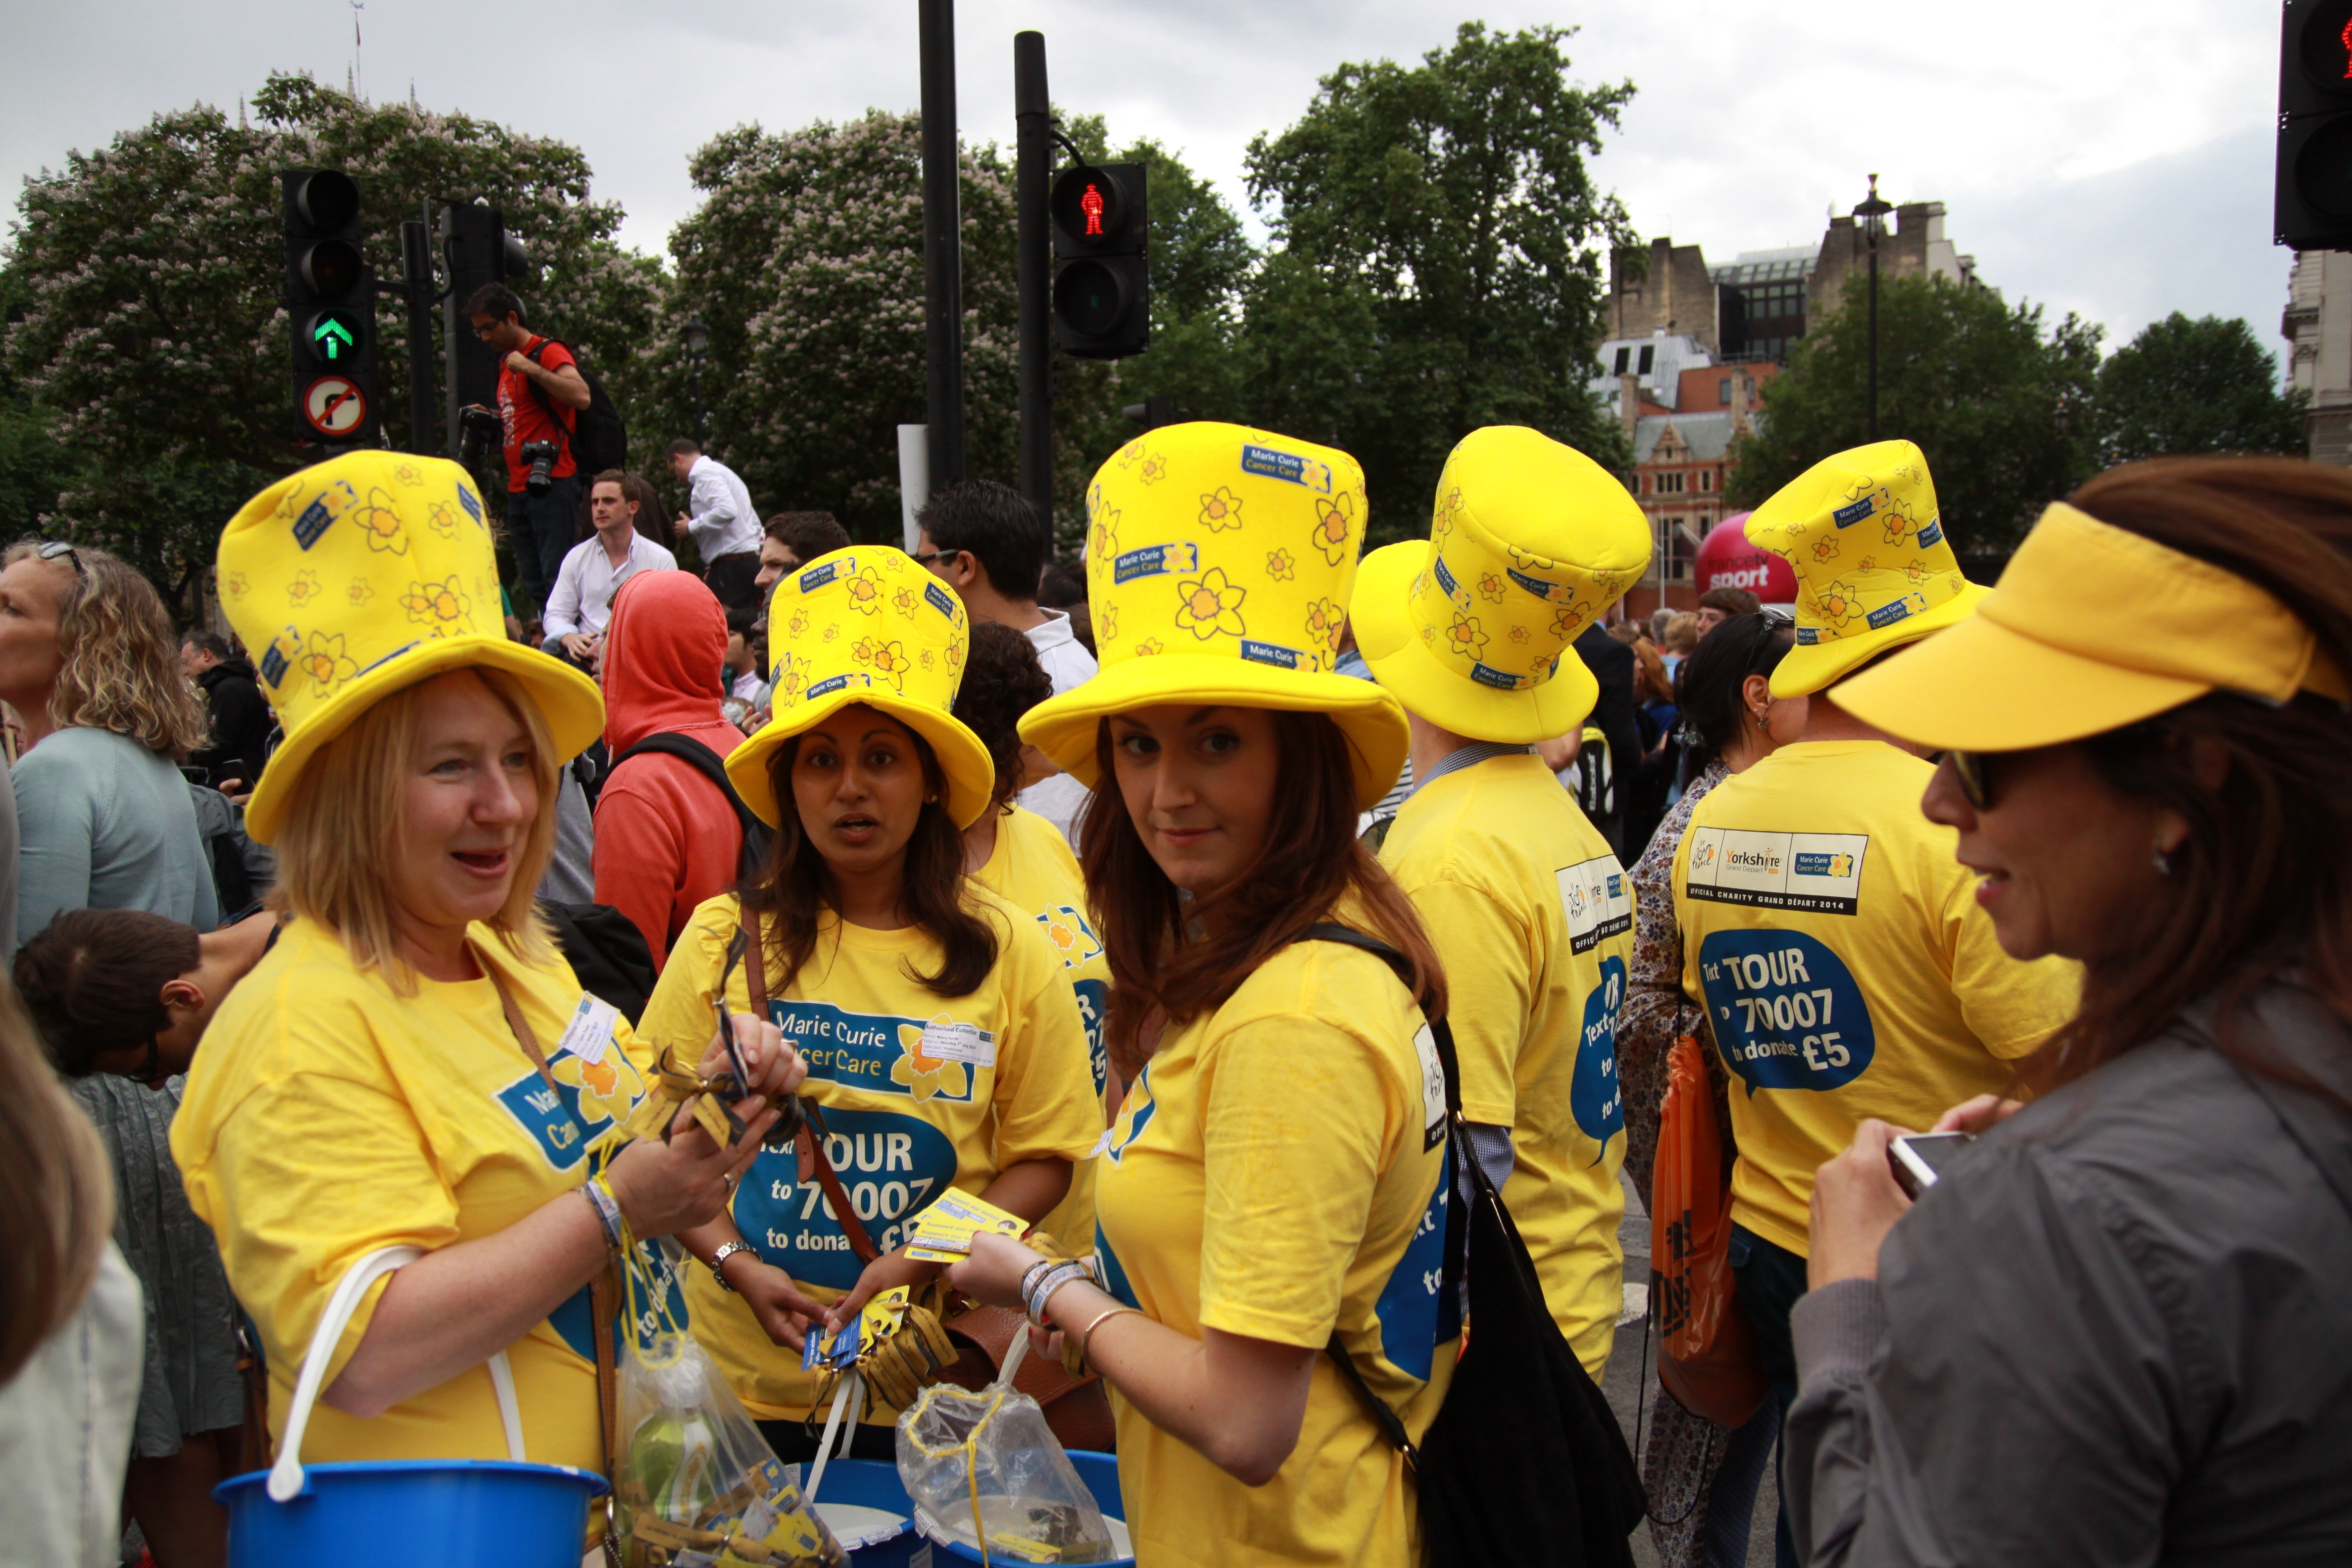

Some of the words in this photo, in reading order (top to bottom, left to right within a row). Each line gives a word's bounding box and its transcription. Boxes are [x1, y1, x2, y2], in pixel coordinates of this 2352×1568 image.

[1246, 459, 1276, 472] Cancer
[1278, 465, 1298, 477] Care
[1251, 449, 1276, 462] Marie
[1278, 455, 1299, 468] Curie
[1839, 509, 1855, 518] Marie
[1856, 501, 1868, 511] Curie
[1839, 515, 1858, 525] Cancer
[1859, 508, 1870, 517] Care
[1119, 554, 1138, 568] Marie
[1139, 550, 1160, 561] Curie
[804, 572, 817, 582] Marie
[818, 566, 831, 575] Curie
[1117, 566, 1139, 579] Cancer
[1141, 562, 1160, 571] Care
[1710, 564, 1769, 589] sport
[803, 579, 819, 589] Cancer
[1445, 574, 1454, 587] Curie
[1530, 581, 1546, 590] Curie
[927, 592, 941, 606] Cancer
[941, 603, 950, 614] Care
[931, 587, 942, 599] Marie
[942, 596, 951, 608] Curie
[1872, 610, 1888, 621] Marie
[1888, 604, 1902, 612] Curie
[1873, 616, 1892, 628] Cancer
[1250, 644, 1274, 658] Marie
[1274, 650, 1293, 663] Curie
[1474, 673, 1496, 686] Cancer
[1479, 667, 1497, 679] Marie
[811, 684, 825, 695] Marie
[827, 677, 842, 687] Curie
[1726, 848, 1780, 871] Yorkshire
[1690, 888, 1714, 897] OFFICIAL
[1717, 891, 1753, 901] CHARITY
[1758, 895, 1783, 905] GRAND
[1787, 897, 1816, 907] DÉPART
[1820, 901, 1844, 909] 2014
[1722, 948, 1811, 990] TOUR
[1735, 988, 1832, 1033] 70007
[776, 1010, 831, 1037] Marie
[836, 1021, 886, 1048] Curie
[926, 1024, 954, 1032] Authorised
[1585, 1012, 1609, 1048] Text
[1732, 1045, 1743, 1062] to
[1745, 1040, 1799, 1060] donate
[1802, 1031, 1851, 1071] £5
[799, 1048, 833, 1066] cer
[836, 1049, 882, 1077] Care
[1601, 1057, 1613, 1078] to
[1602, 1100, 1613, 1121] to
[818, 1132, 913, 1172] OUR
[771, 1179, 791, 1200] to
[947, 1193, 970, 1207] Support
[980, 1209, 1000, 1221] nurses
[951, 1203, 964, 1213] TOUR
[969, 1213, 985, 1223] 70007
[767, 1227, 789, 1249] to
[795, 1229, 852, 1251] dona
[636, 1311, 657, 1337] to
[926, 1320, 937, 1334] 70007
[936, 1339, 947, 1351] TOUR
